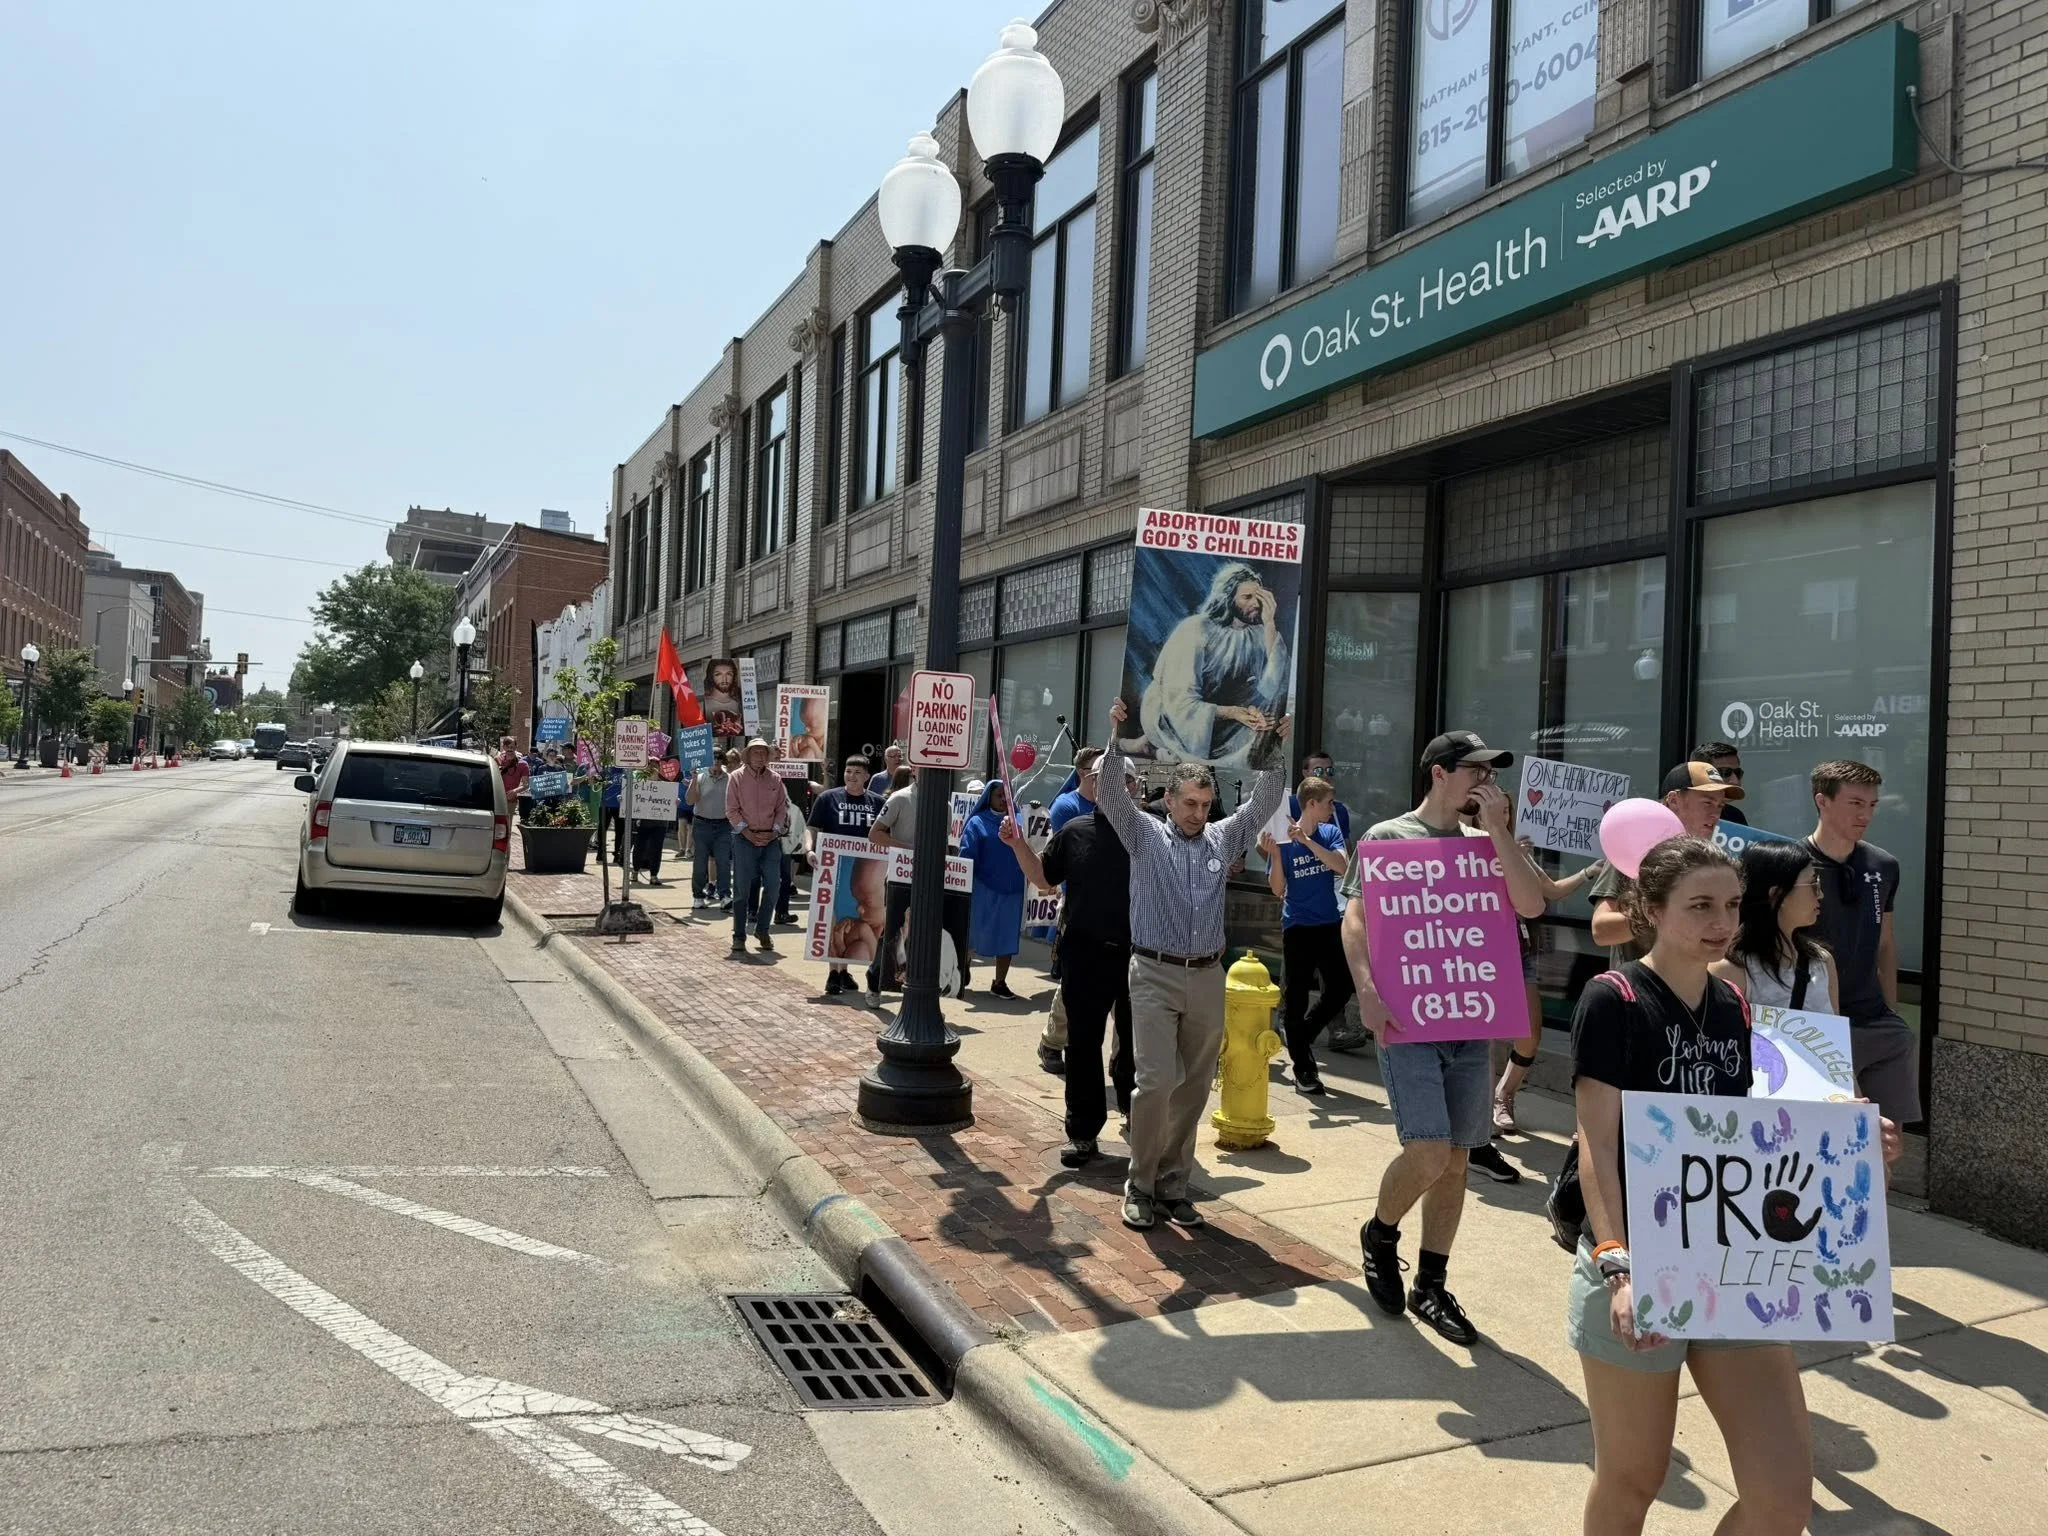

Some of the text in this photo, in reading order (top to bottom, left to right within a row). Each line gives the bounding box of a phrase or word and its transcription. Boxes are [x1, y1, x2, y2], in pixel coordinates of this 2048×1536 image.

[1419, 70, 1477, 113] NATHAN
[1481, 22, 1558, 76] BYANT,
[1576, 159, 1667, 210] Selected by
[1576, 163, 1712, 248] AARP
[1301, 228, 1546, 366] Oak St. Health
[1145, 511, 1298, 541] ABORTION KILLS
[1204, 536, 1298, 560] CHILDREN
[780, 687, 809, 695] ABORTION
[932, 683, 954, 700] NO
[916, 701, 967, 721] PARKING
[1759, 700, 1823, 719] Oak St.
[1834, 713, 1877, 722] Selected by
[625, 725, 638, 734] NO
[680, 728, 708, 739] Abortion
[779, 695, 789, 759] BABIES
[918, 720, 963, 735] LOADING
[1760, 720, 1818, 738] Health
[1834, 723, 1888, 737] AARP
[617, 734, 645, 744] PARKING
[683, 739, 700, 748] takes
[926, 734, 953, 747] ZONE
[684, 749, 706, 758] human
[691, 759, 701, 767] life
[533, 774, 563, 783] Abortion
[1526, 761, 1630, 797] ONE HEART STOPS
[838, 802, 875, 813] CHOOSE
[953, 794, 967, 820] Pray
[838, 810, 875, 828] LIFE
[1520, 808, 1601, 833] MANY HEAR
[821, 837, 868, 853] ABORTION
[1546, 826, 1592, 851] BREAK
[945, 860, 968, 874] Kills
[1362, 851, 1505, 887] Keep the
[944, 874, 966, 887] dren
[811, 850, 835, 957] BABIES
[1379, 888, 1500, 916] unborn
[1872, 884, 1882, 924] FREEDOM
[1403, 919, 1485, 949] alive
[1400, 955, 1497, 985] in the
[1411, 991, 1496, 1026] (815)
[1750, 1004, 1853, 1083] LEY COLLEGE
[1719, 1248, 1813, 1286] LIFE
